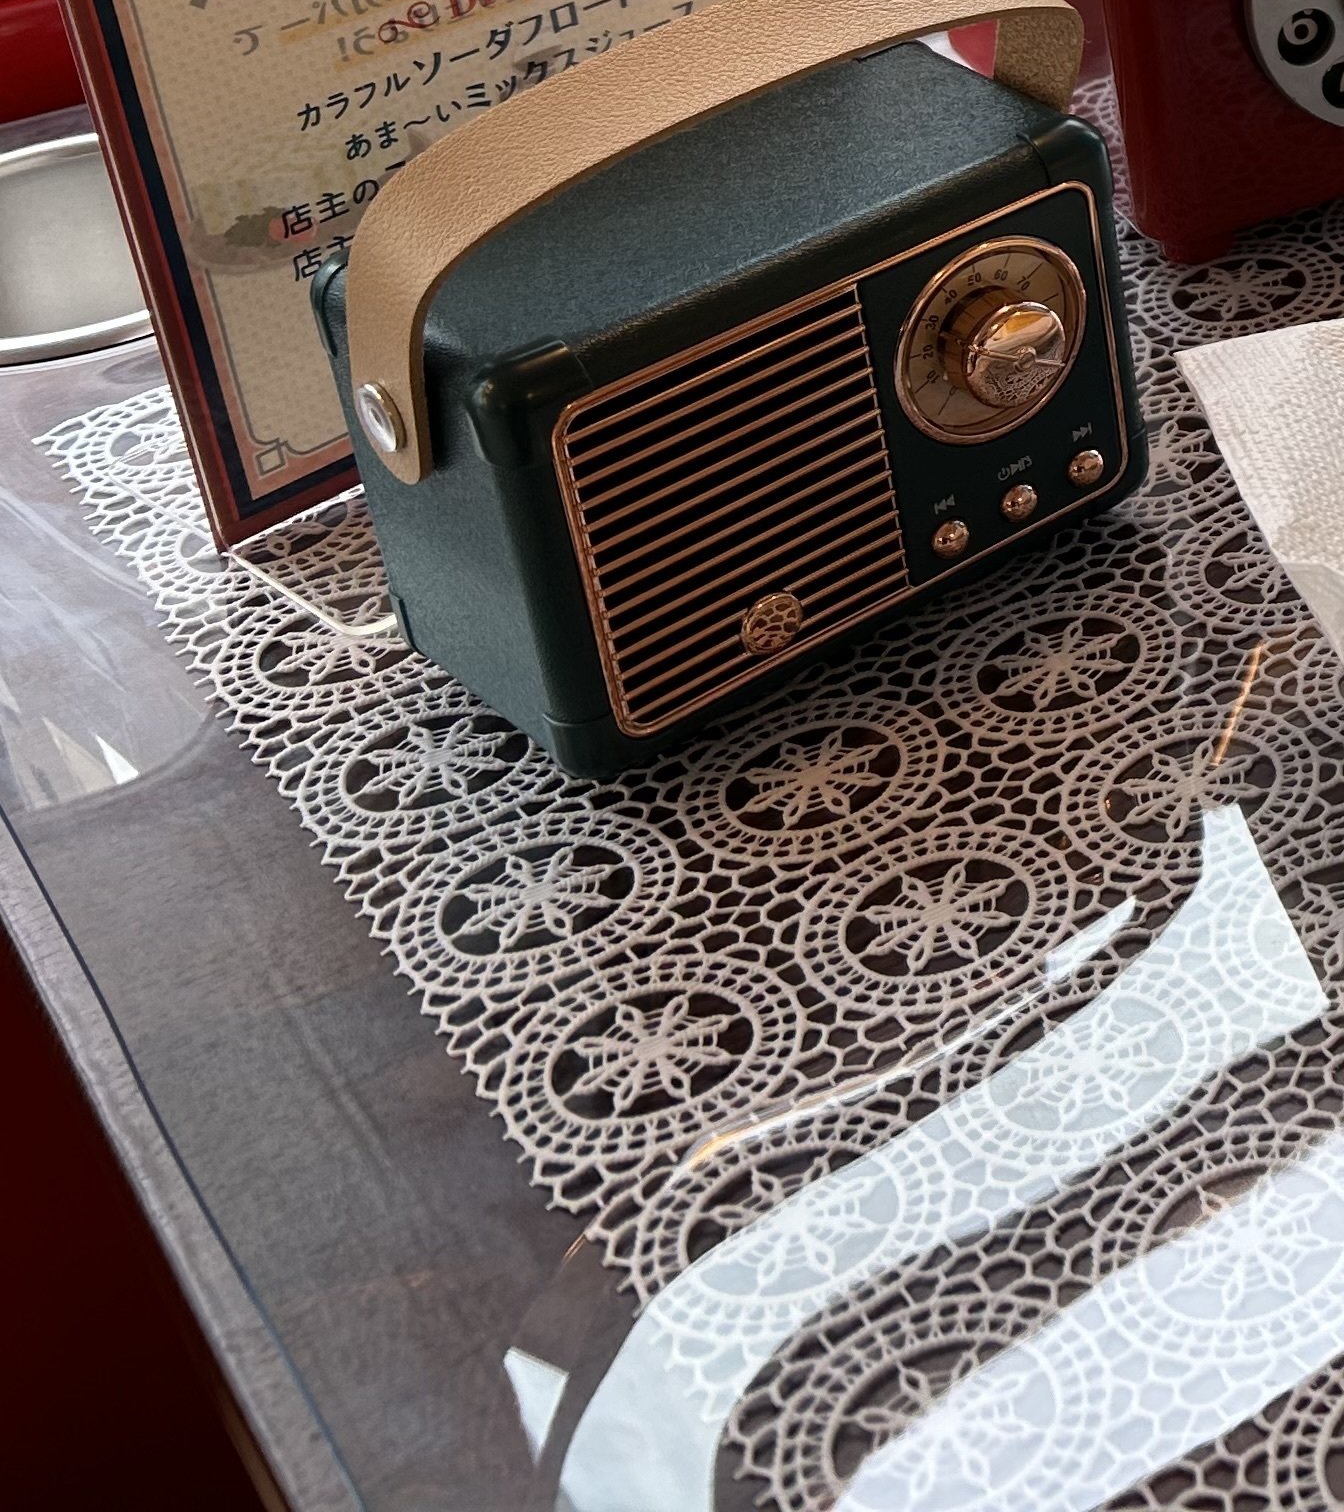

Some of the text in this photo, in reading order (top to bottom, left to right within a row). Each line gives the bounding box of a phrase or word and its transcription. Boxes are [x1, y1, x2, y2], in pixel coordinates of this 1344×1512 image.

[1283, 9, 1319, 45] 6
[282, 160, 406, 239] 店主の
